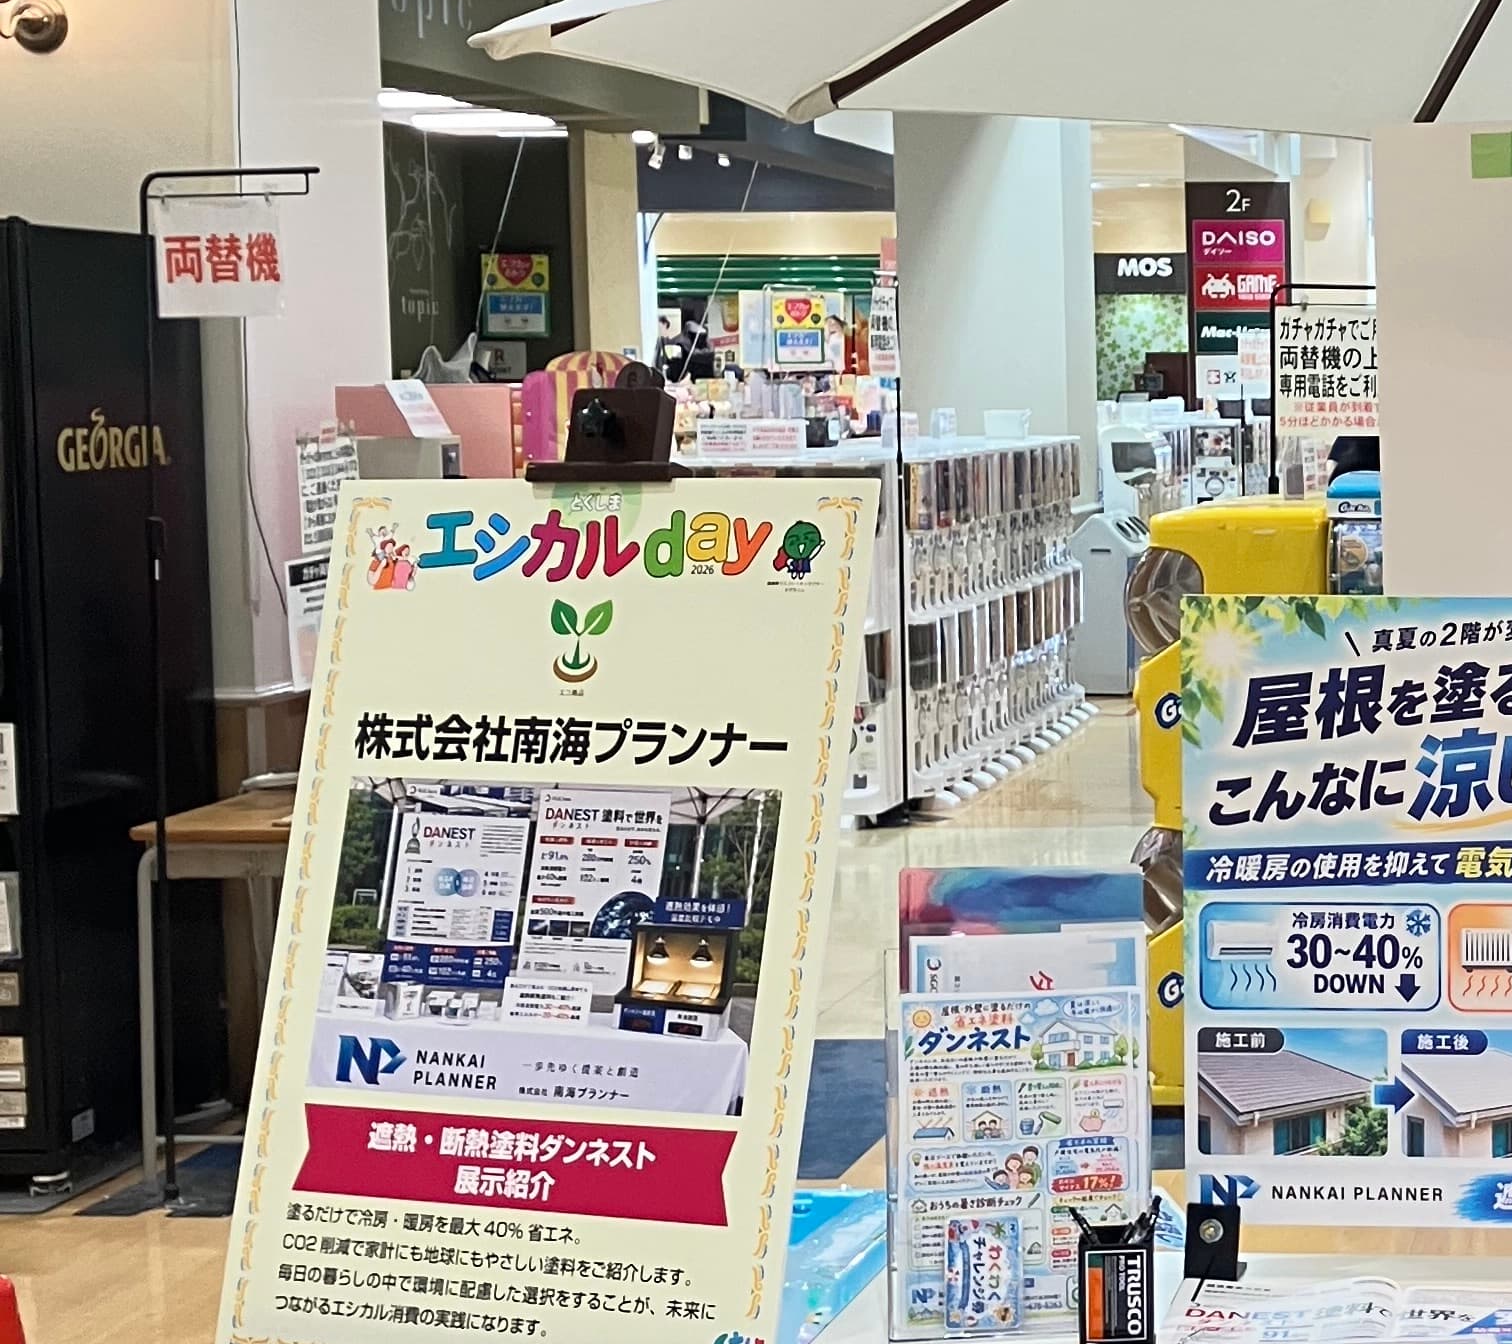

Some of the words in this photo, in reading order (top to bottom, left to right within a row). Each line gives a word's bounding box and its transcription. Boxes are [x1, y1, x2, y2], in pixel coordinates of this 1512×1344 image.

[1226, 188, 1251, 212] 2F
[1202, 231, 1276, 246] DAISO
[164, 232, 281, 284] 両替機
[1118, 258, 1173, 277] MOS
[57, 407, 168, 472] GEORGIA
[690, 564, 715, 575] 2026
[355, 712, 789, 769] 株式会社南海プランナー
[1291, 912, 1396, 931] 冷房消費電力
[1314, 974, 1385, 995] DOWN
[918, 1025, 1031, 1056] ダンネスト
[1215, 1031, 1266, 1050] 施工前
[1416, 1032, 1470, 1051] 施工後
[416, 1049, 486, 1068] NANKAI
[413, 1070, 497, 1090] PLANNER
[367, 1121, 657, 1169] 遮熱・断熱塗料ダンネスト
[453, 1163, 556, 1201] 展示紹介
[1271, 1184, 1345, 1202] NANKAI
[1353, 1186, 1443, 1203] PLANNER
[1126, 1254, 1142, 1336] TRUSCO
